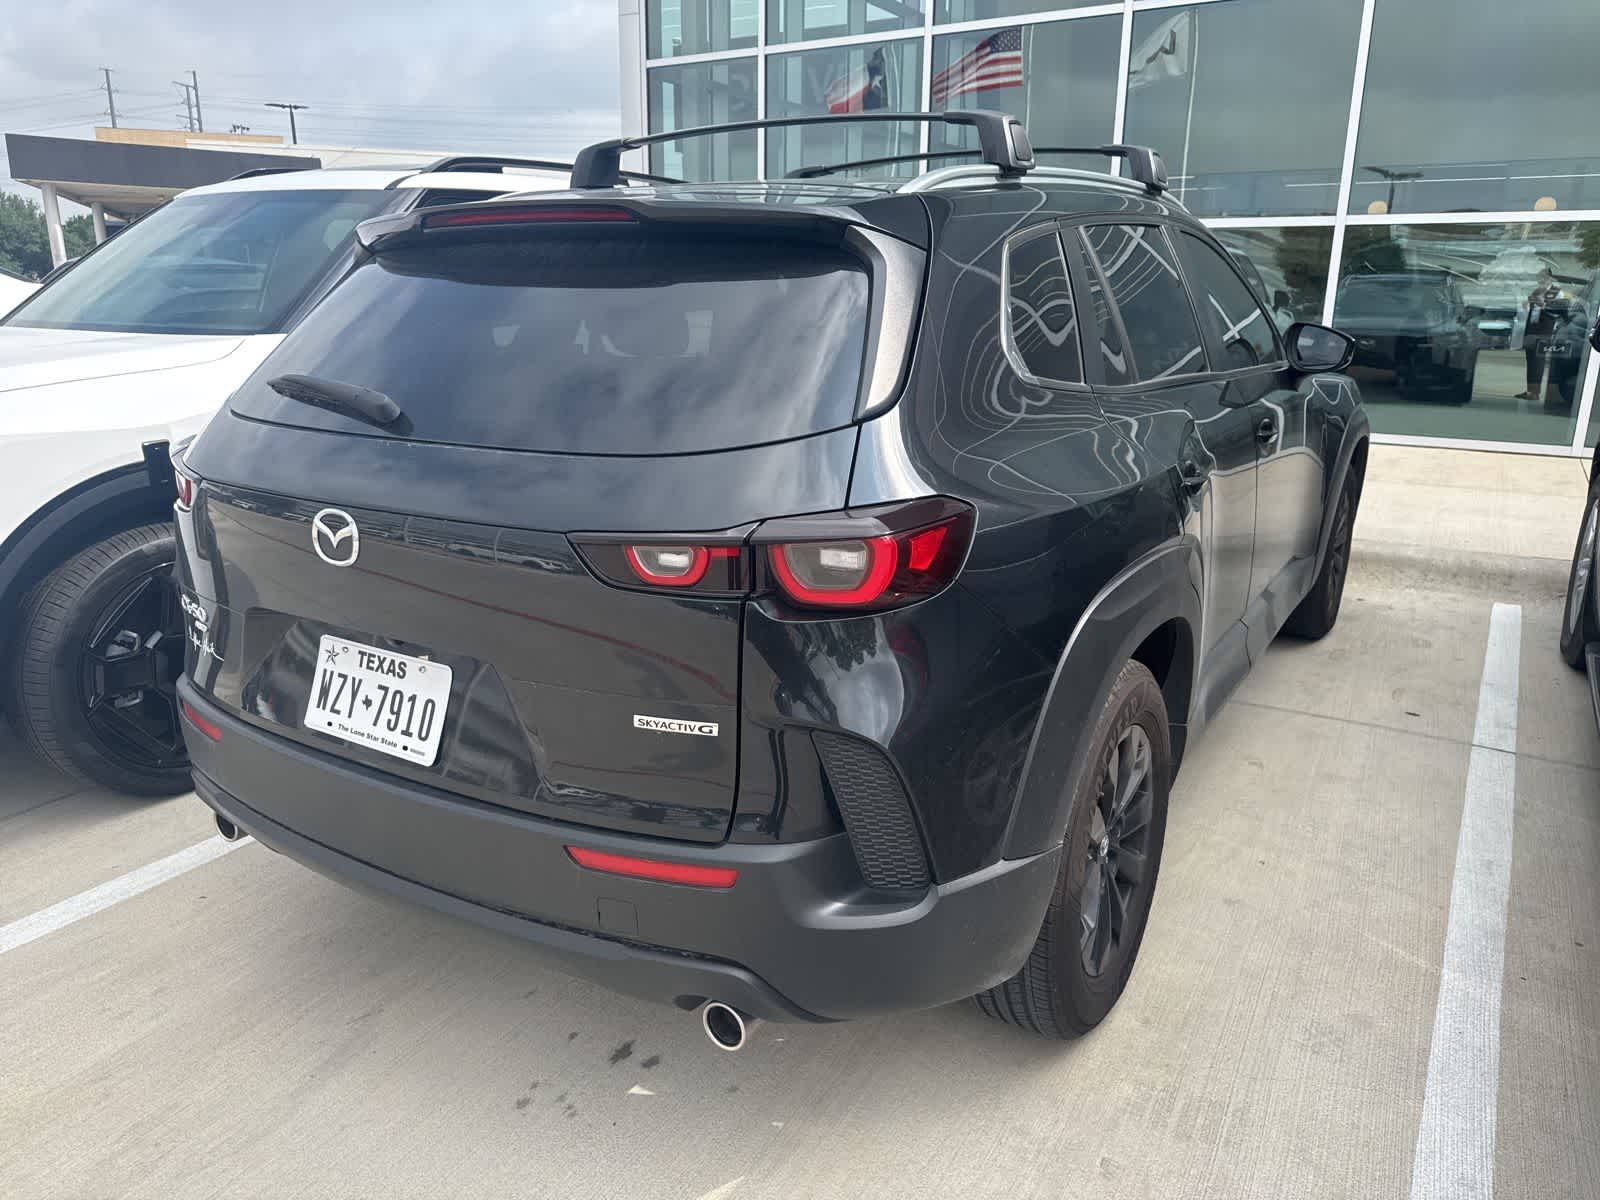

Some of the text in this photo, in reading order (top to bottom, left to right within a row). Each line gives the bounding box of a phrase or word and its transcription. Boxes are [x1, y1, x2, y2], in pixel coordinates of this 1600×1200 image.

[357, 649, 408, 680] TEXAS
[338, 723, 398, 748] The Lone Star State
